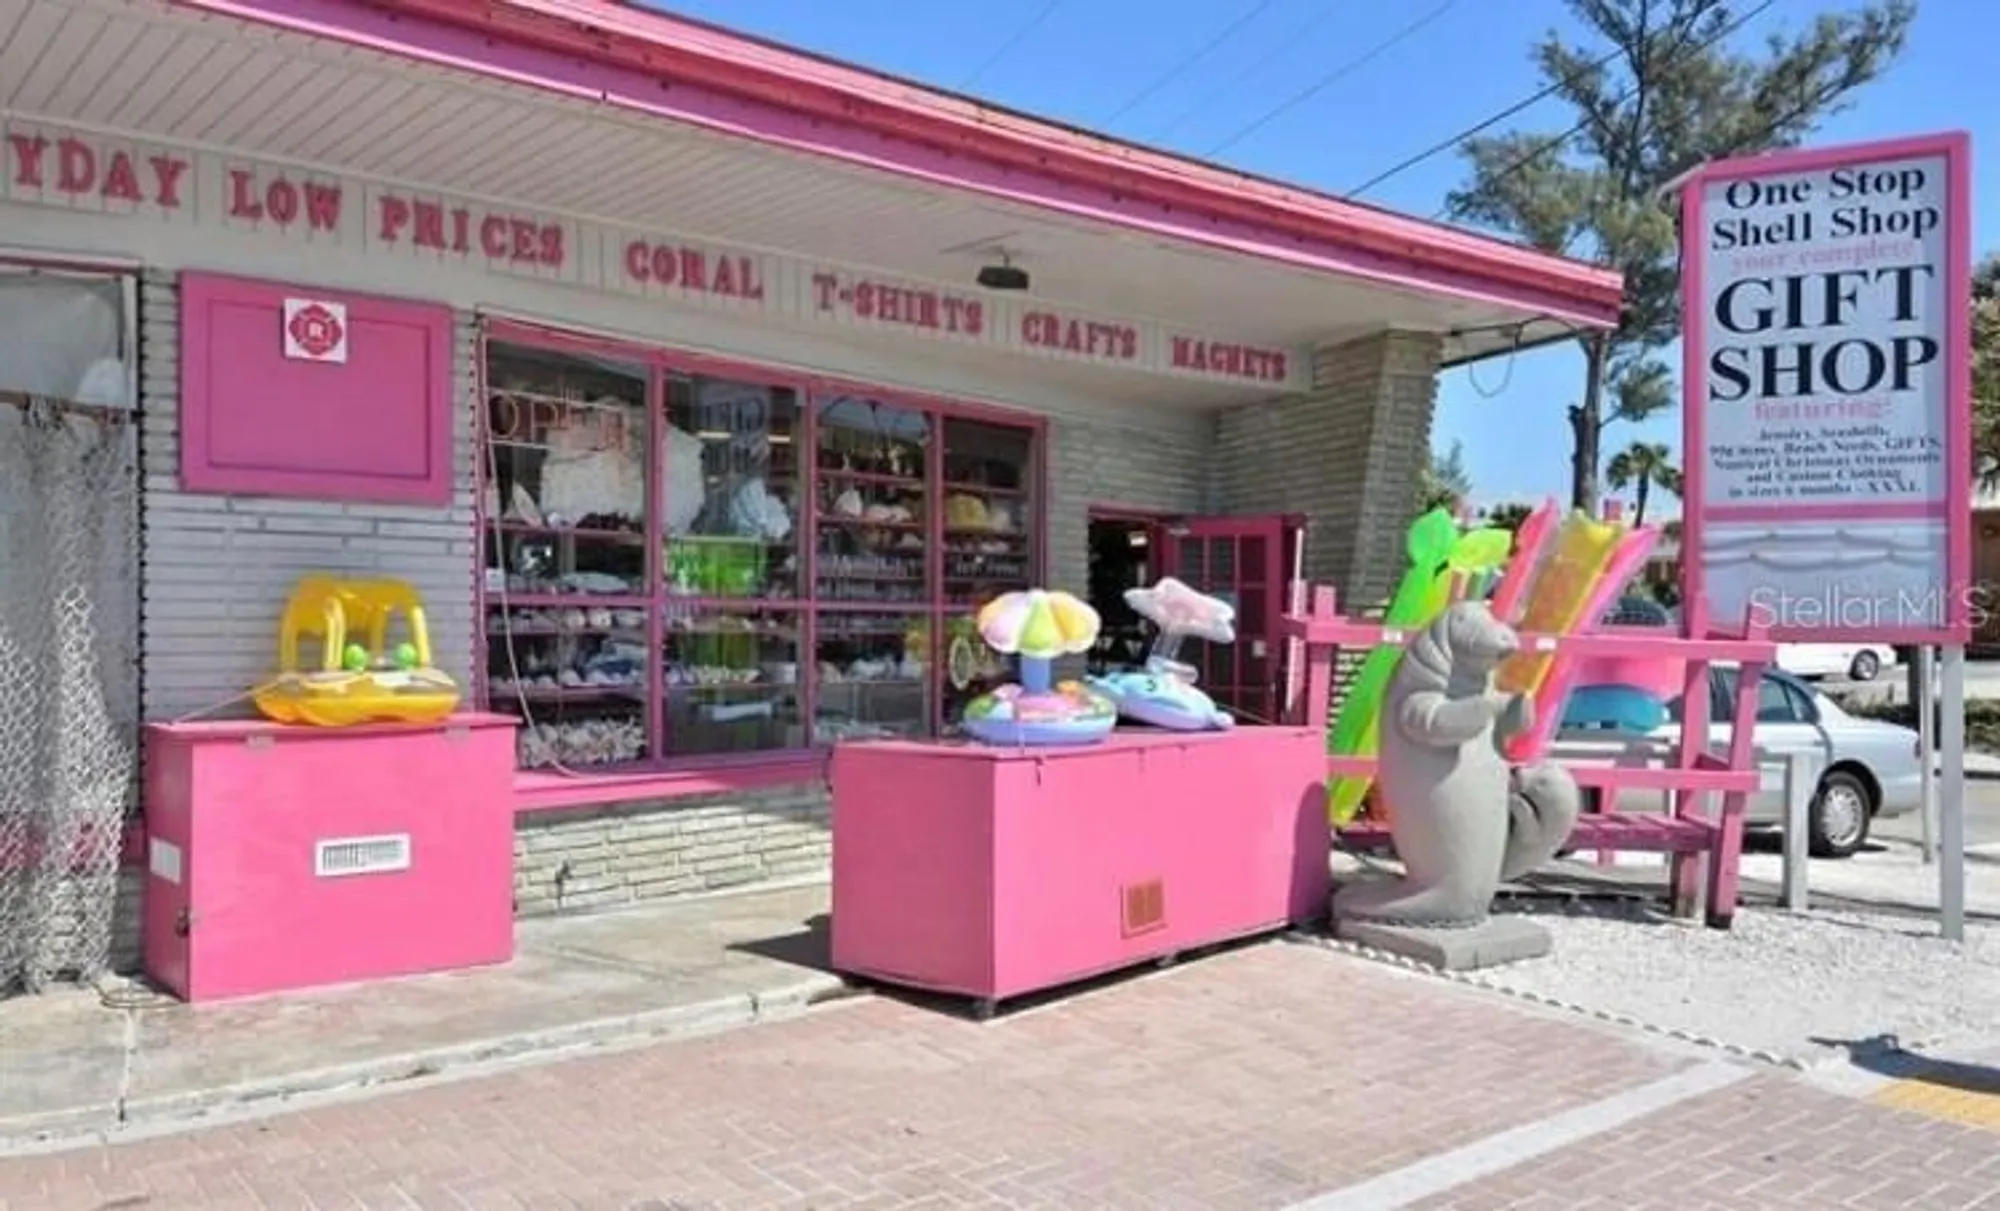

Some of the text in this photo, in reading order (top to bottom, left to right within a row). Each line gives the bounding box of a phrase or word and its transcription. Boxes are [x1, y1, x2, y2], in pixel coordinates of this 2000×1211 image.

[1725, 168, 1926, 210] One Stop
[1712, 205, 1940, 250] Shell Shop
[7, 131, 1287, 383] YDAY LOW PRICES CORAL T-SHIRTS CRAFTS MAGNETS
[1714, 264, 1935, 335] GIFT
[1708, 336, 1941, 402] SHOP
[1747, 471, 1771, 483] and
[1774, 455, 1850, 468] Christmas
[1856, 452, 1940, 466] Ornaments
